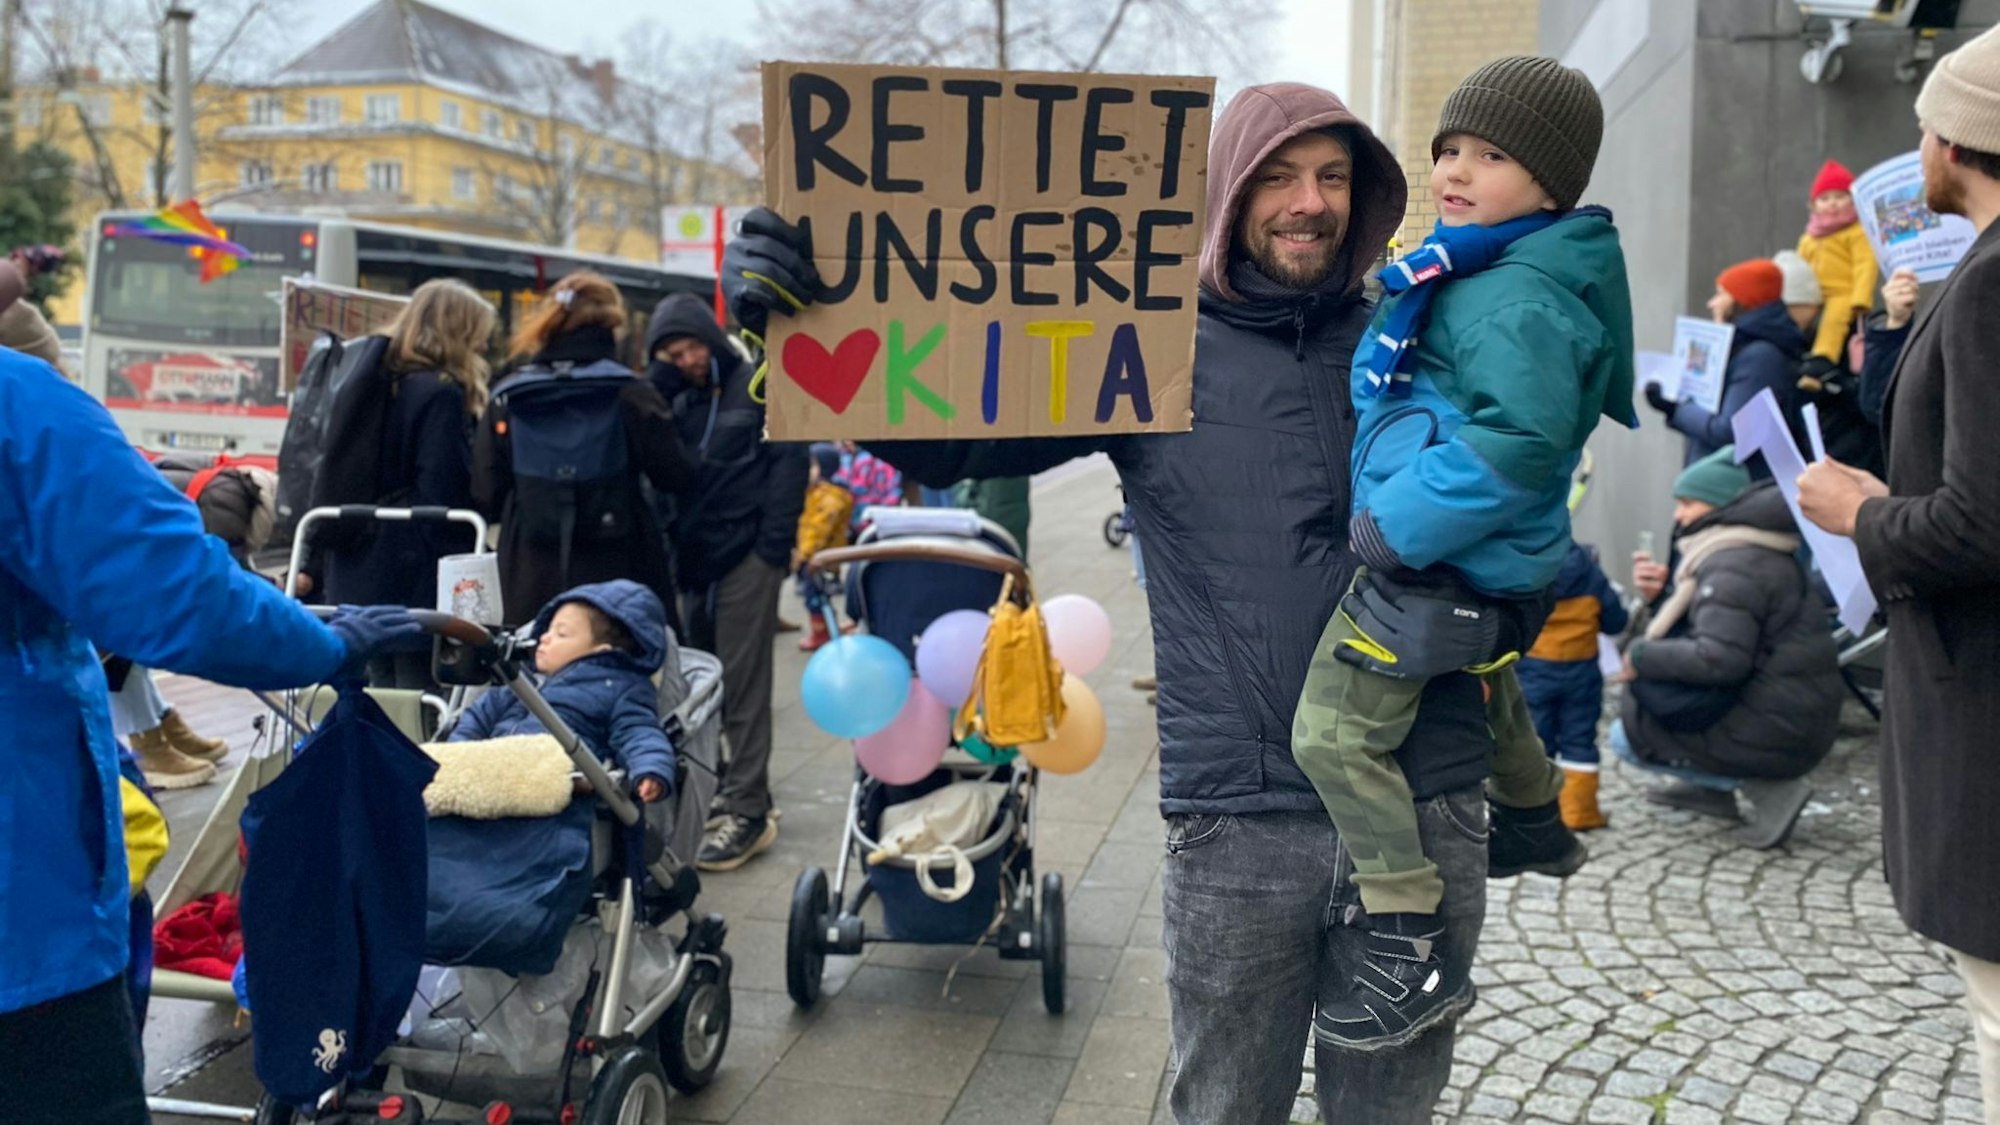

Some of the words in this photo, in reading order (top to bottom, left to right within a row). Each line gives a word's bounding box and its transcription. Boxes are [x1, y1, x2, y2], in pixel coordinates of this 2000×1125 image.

[788, 72, 1210, 199] RETTET
[799, 205, 1193, 310] UNSERE
[886, 319, 1154, 425] KITA
